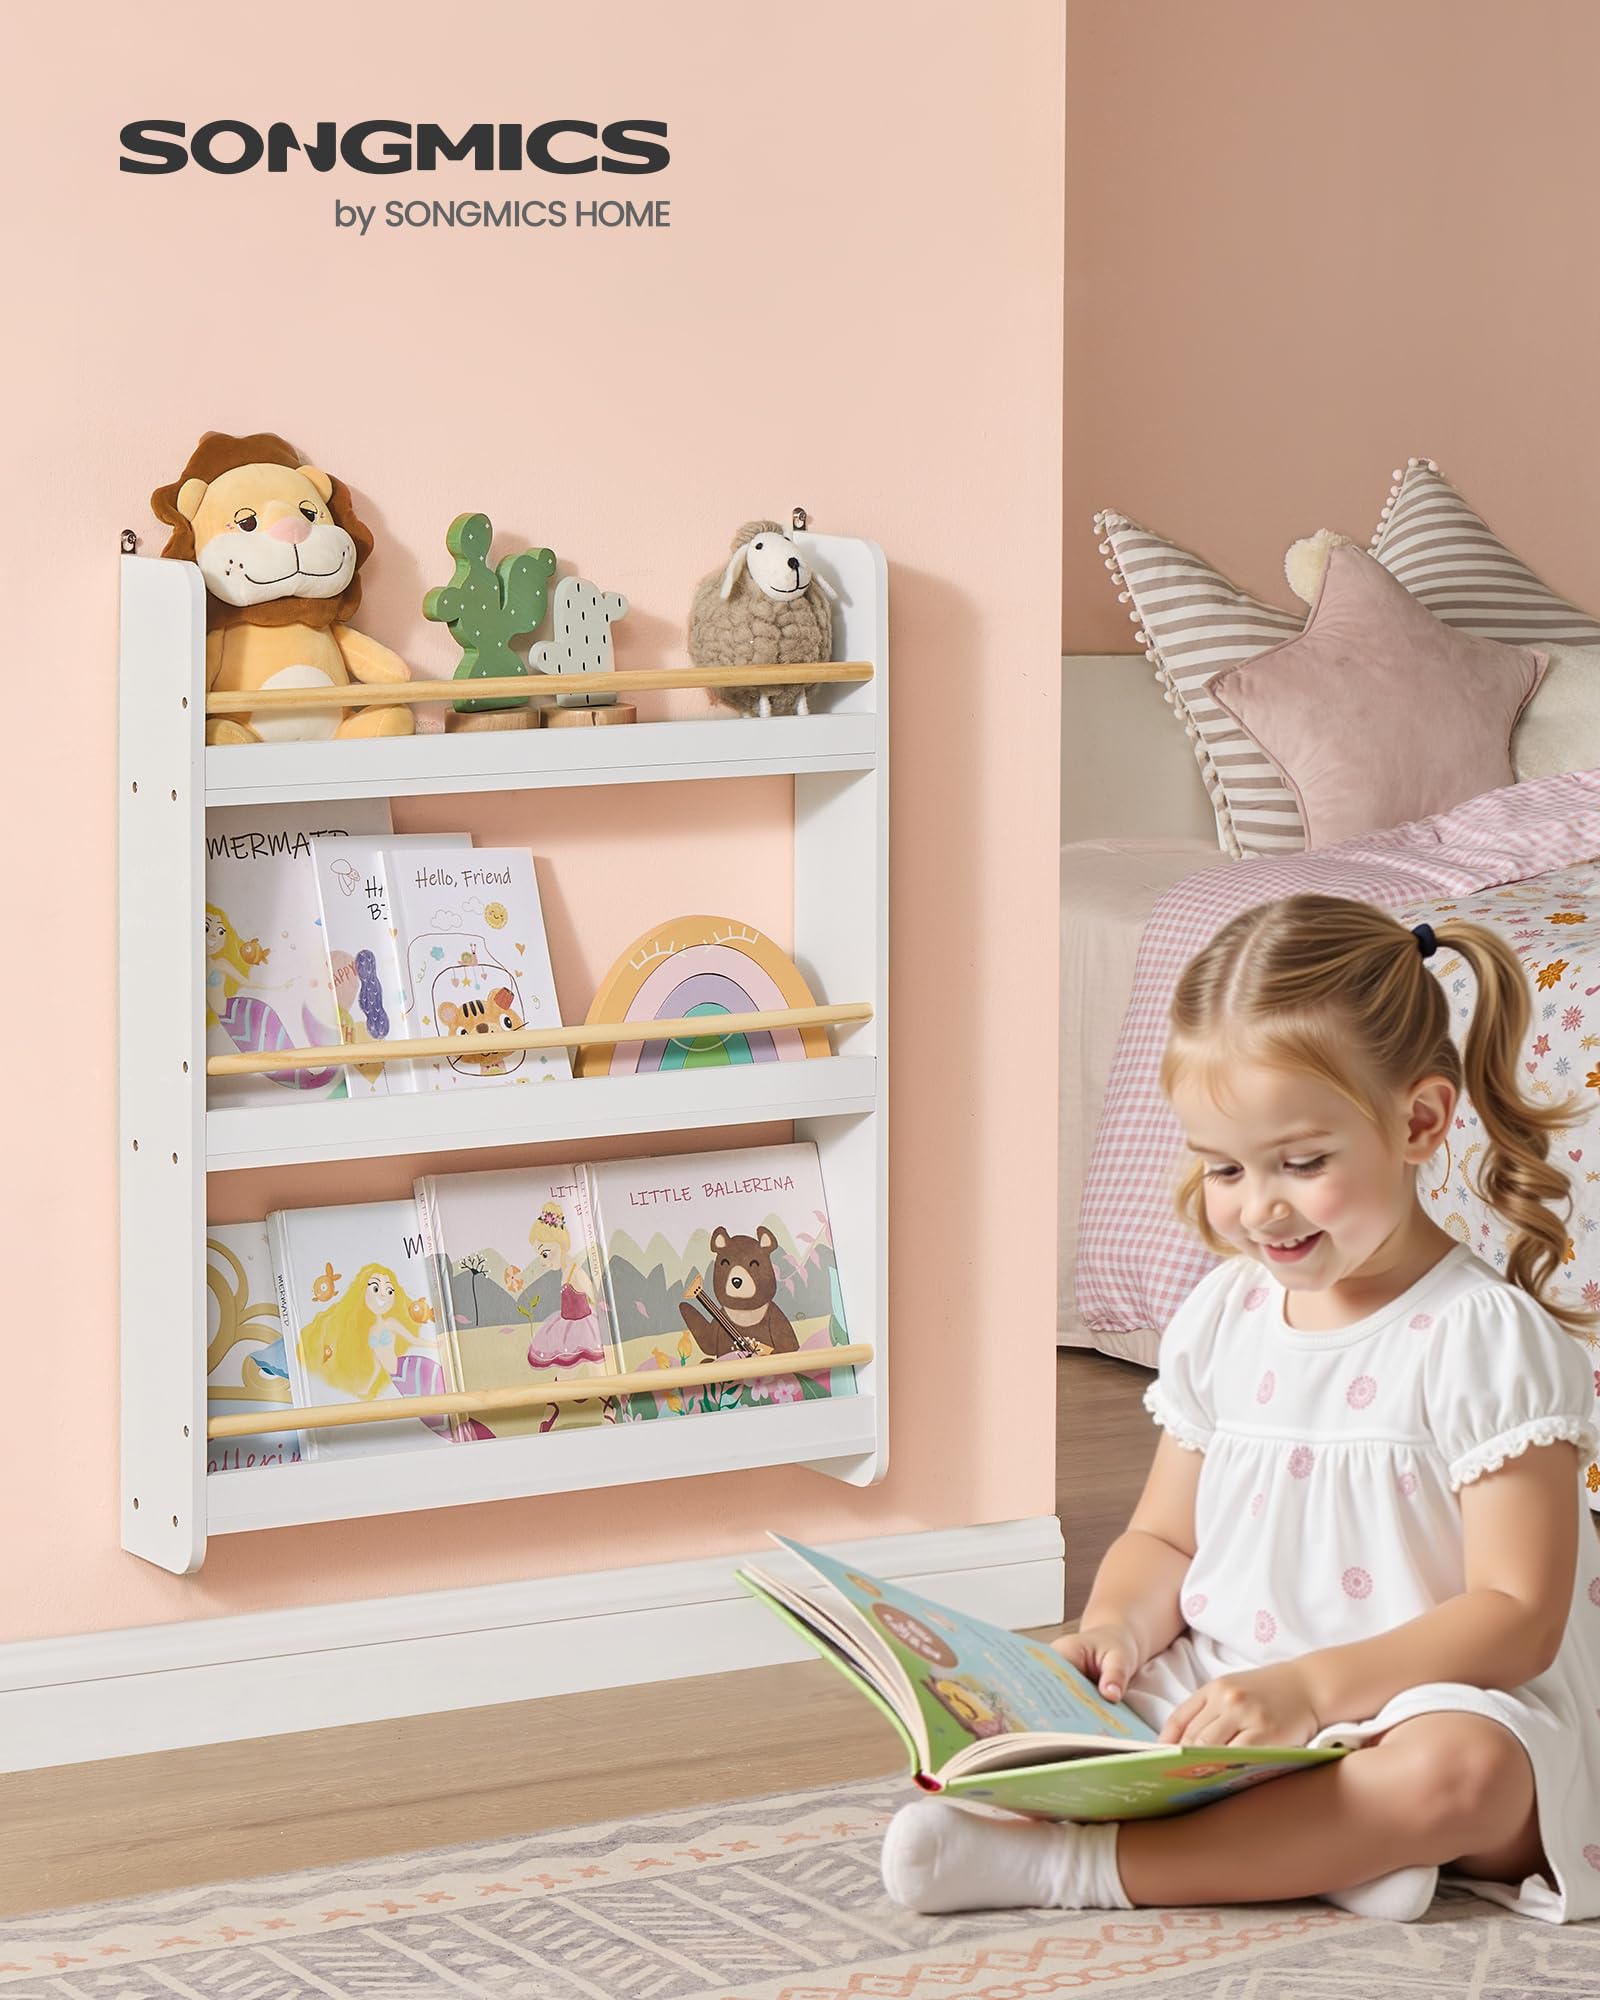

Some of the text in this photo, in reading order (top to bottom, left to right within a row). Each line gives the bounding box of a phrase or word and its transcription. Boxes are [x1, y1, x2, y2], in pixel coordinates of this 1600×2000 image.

[206, 830, 349, 860] MERMA
[415, 866, 512, 889] Hello, Friend
[629, 1175, 795, 1206] LITTLE BALLERINA
